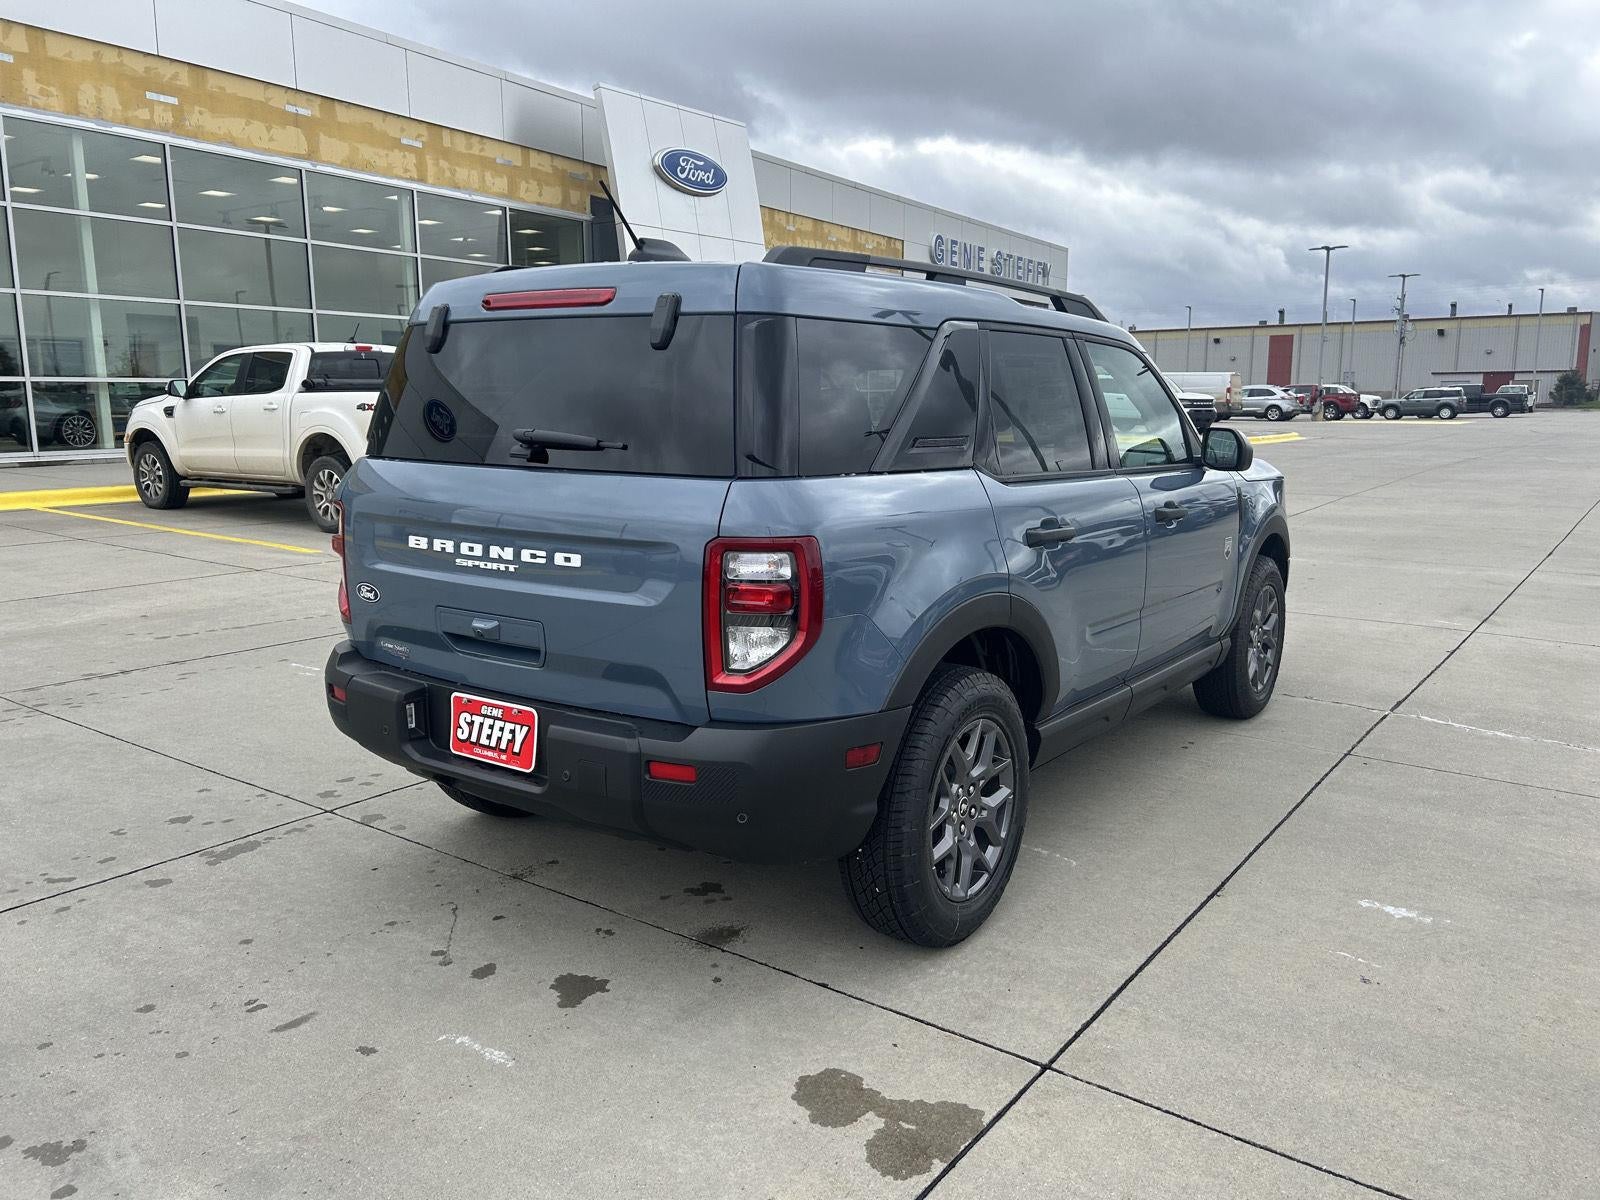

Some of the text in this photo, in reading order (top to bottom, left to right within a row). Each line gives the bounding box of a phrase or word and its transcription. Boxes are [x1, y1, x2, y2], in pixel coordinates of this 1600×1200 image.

[677, 156, 715, 185] Ford
[932, 233, 1052, 287] GENE STEFFY
[408, 535, 582, 568] BRONCO
[455, 558, 519, 573] SPORT
[360, 585, 375, 600] Ford
[481, 705, 503, 719] GENE
[456, 712, 531, 754] STEFFY
[473, 747, 499, 760] COLUMBUS,
